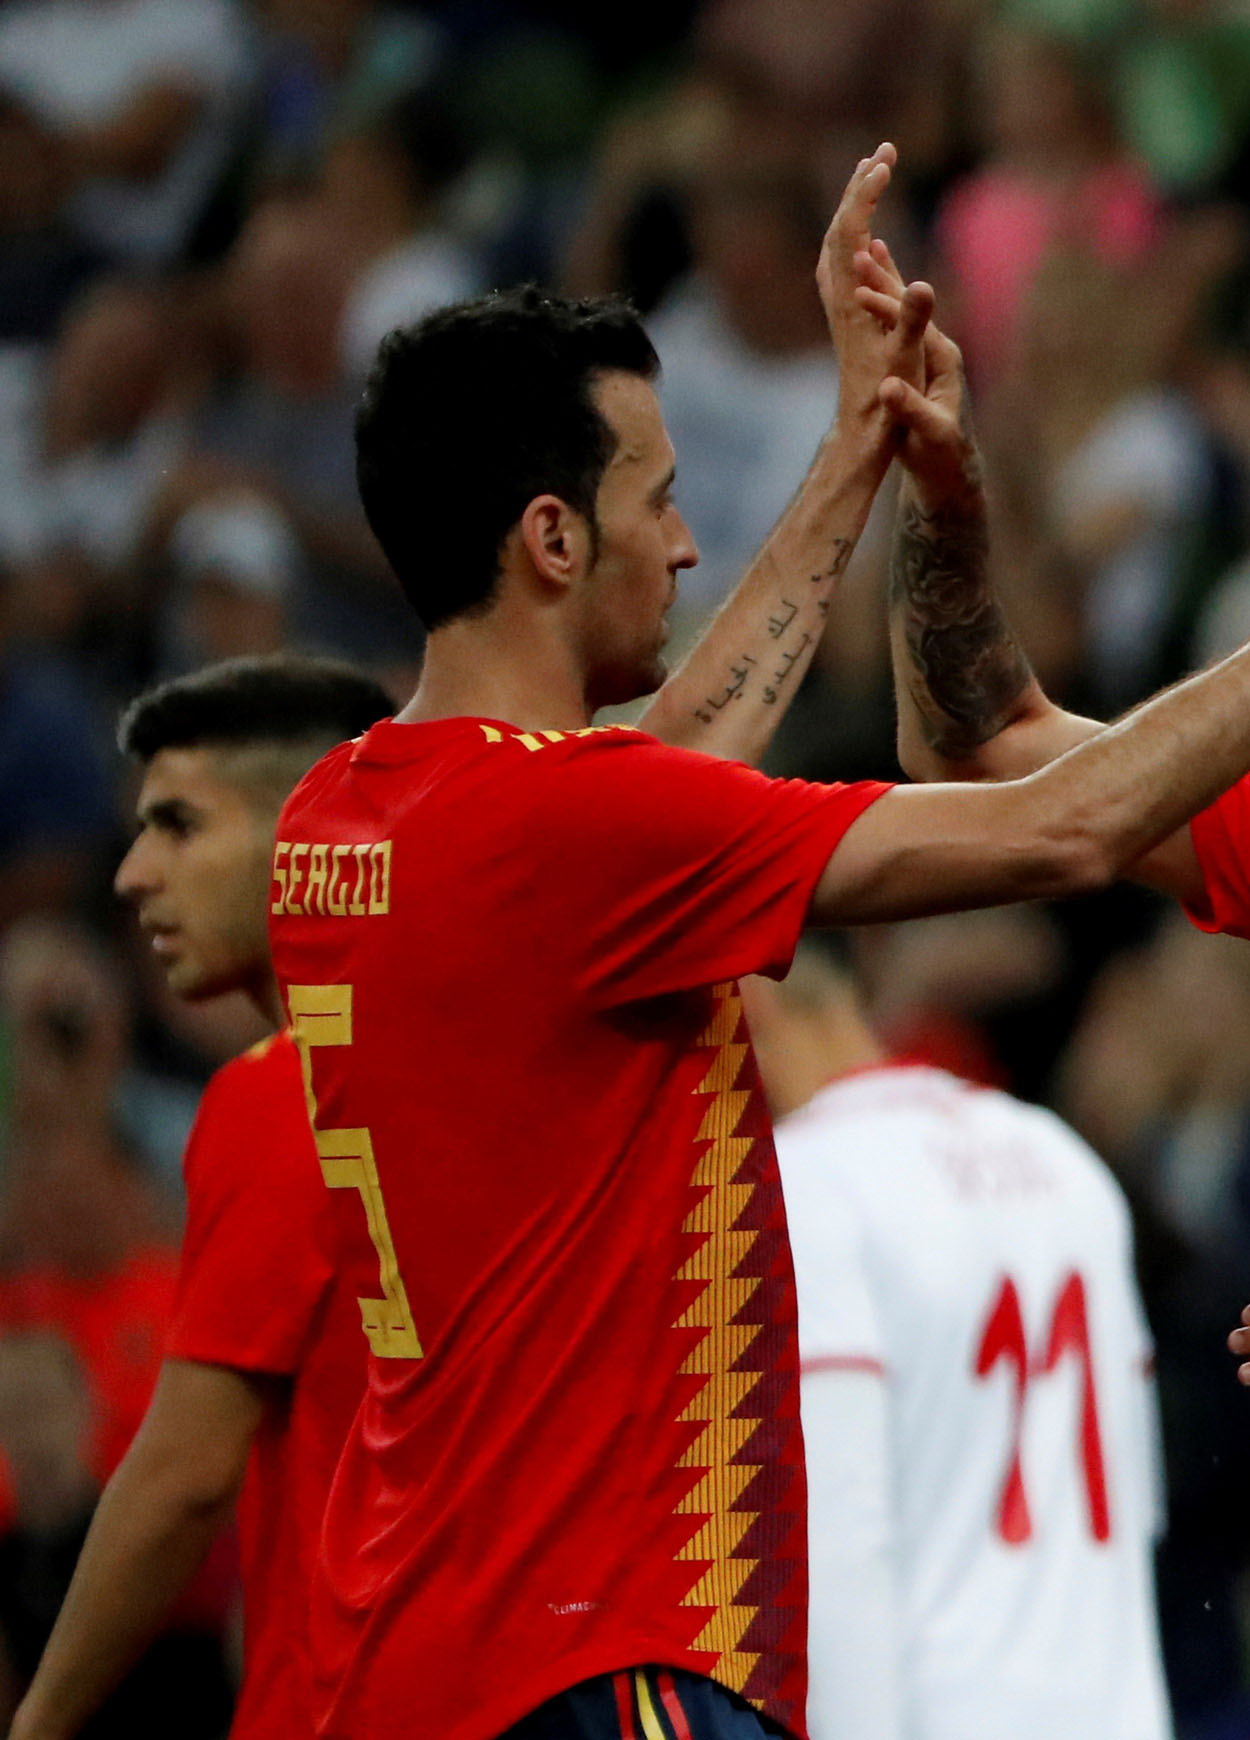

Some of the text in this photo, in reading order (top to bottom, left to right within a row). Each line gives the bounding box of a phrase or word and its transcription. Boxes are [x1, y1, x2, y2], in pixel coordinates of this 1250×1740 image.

[272, 840, 392, 916] SERGIO
[288, 984, 425, 1359] 5
[974, 1268, 1111, 1544] 11
